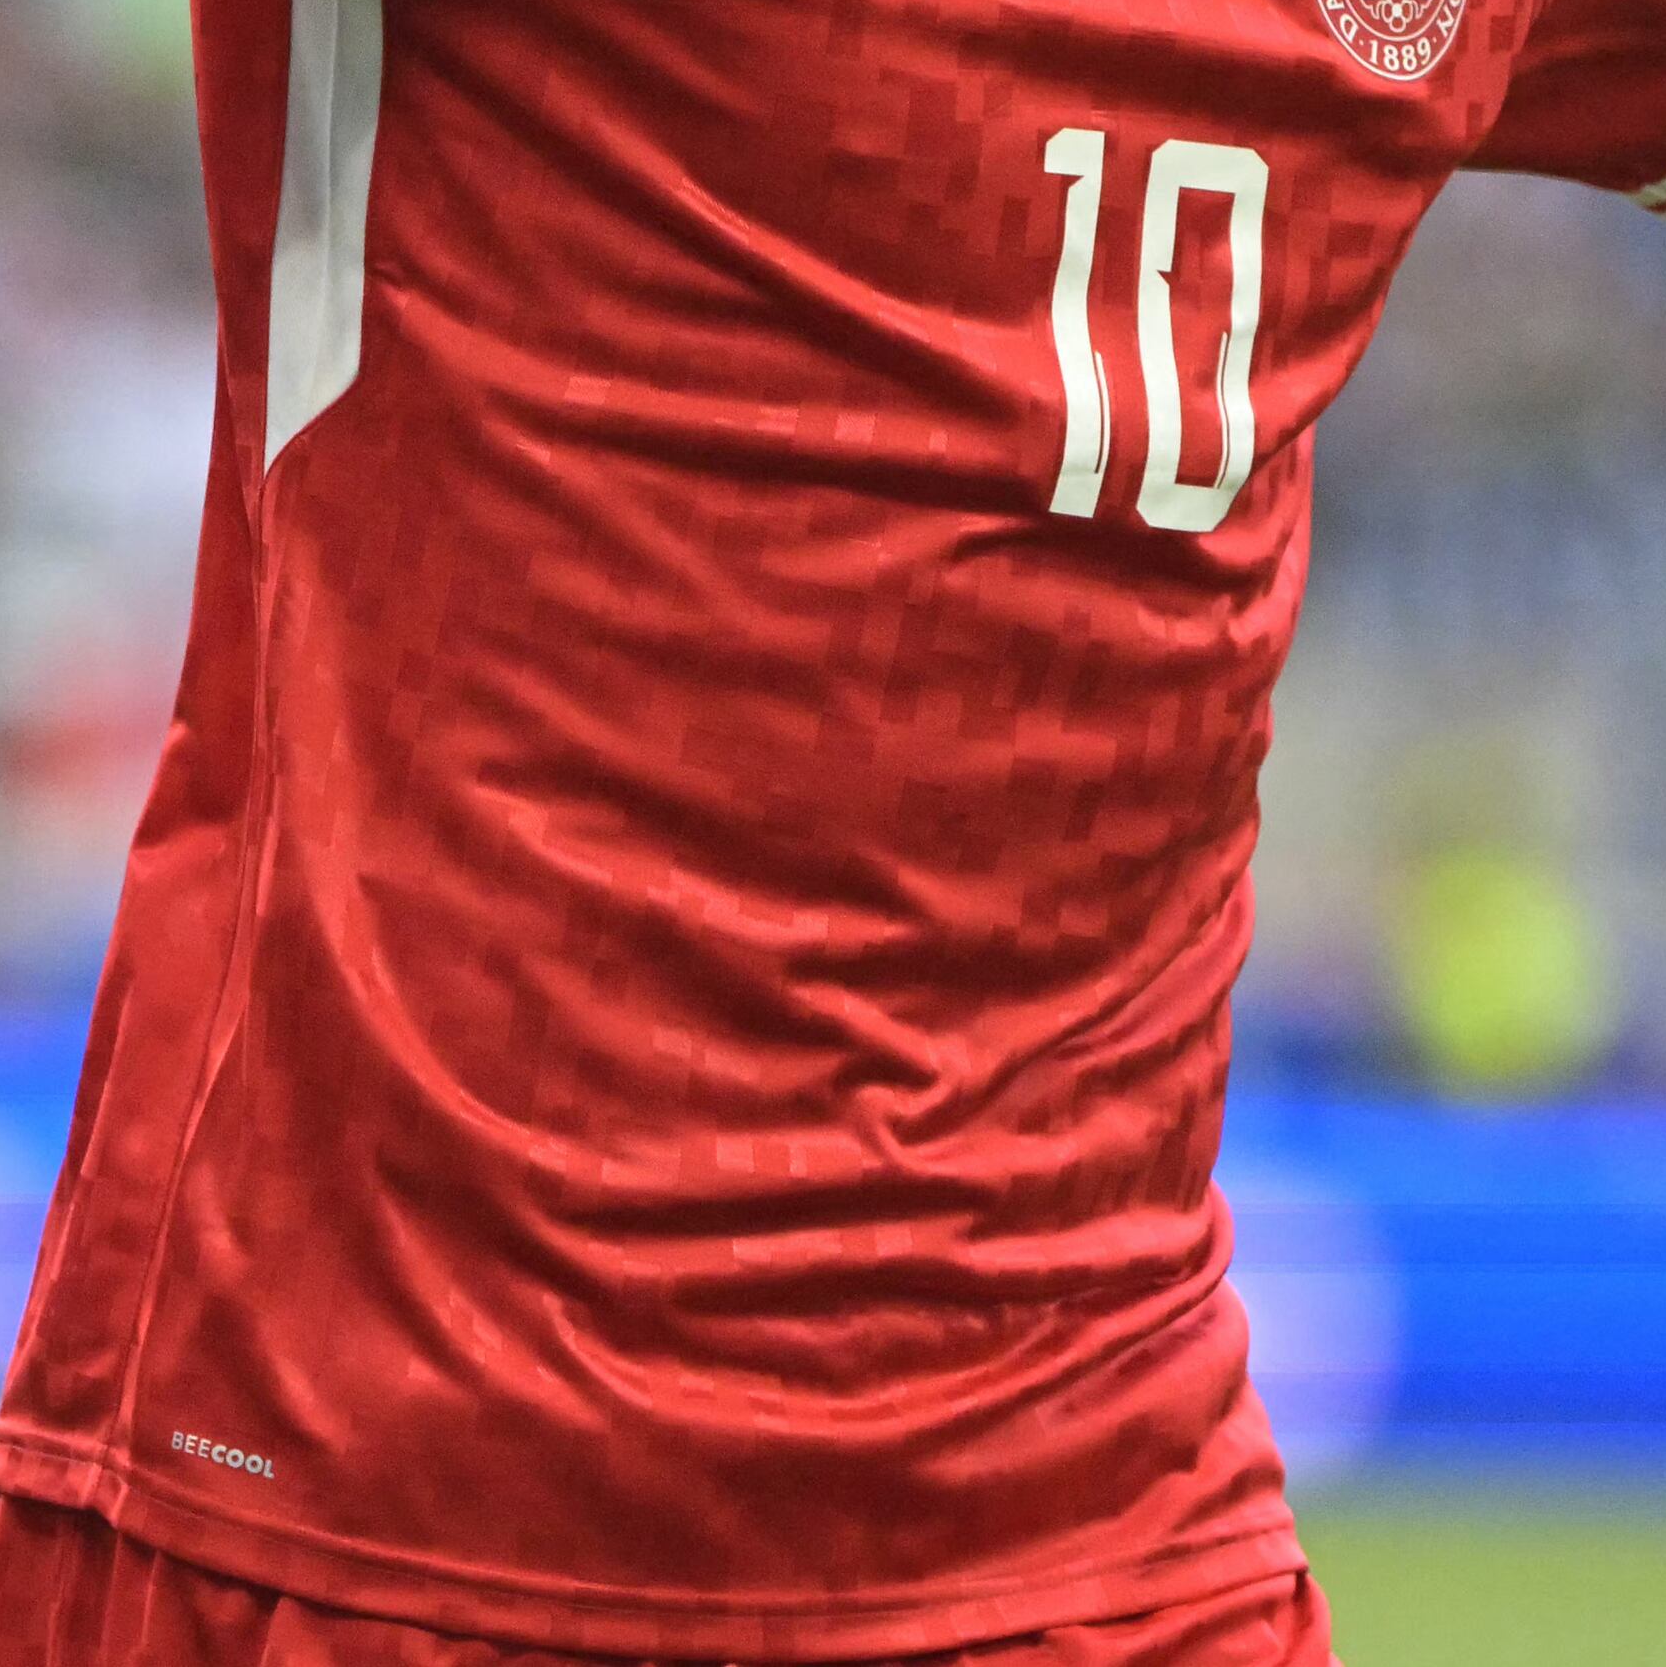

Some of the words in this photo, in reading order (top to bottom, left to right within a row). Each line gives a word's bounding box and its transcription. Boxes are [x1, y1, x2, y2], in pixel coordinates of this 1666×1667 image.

[1368, 38, 1432, 72] 1889
[1044, 127, 1269, 532] 10
[171, 1430, 275, 1480] BEECOOL
